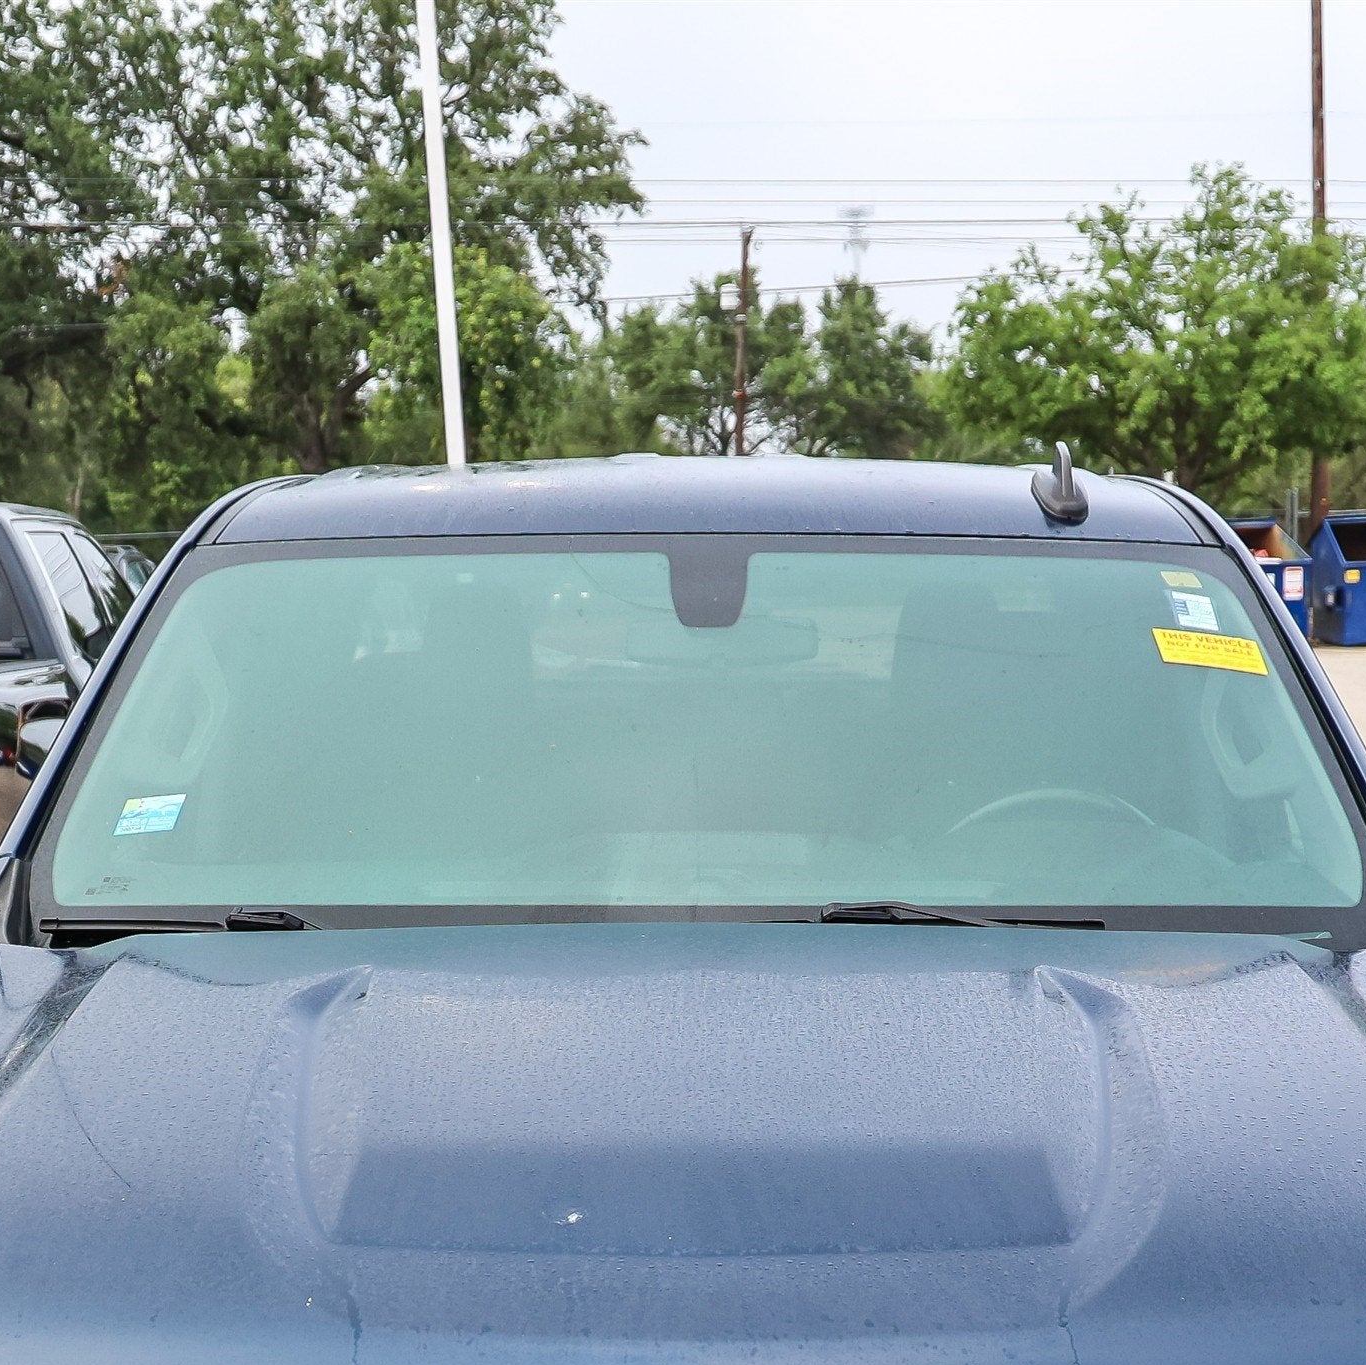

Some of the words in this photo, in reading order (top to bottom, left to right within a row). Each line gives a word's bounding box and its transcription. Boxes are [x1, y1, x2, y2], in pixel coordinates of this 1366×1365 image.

[1161, 631, 1192, 641] THIS
[1196, 635, 1254, 650] VEHICLE
[1166, 640, 1190, 648] NOT
[1195, 641, 1219, 651] FOR
[1224, 647, 1253, 656] SALE
